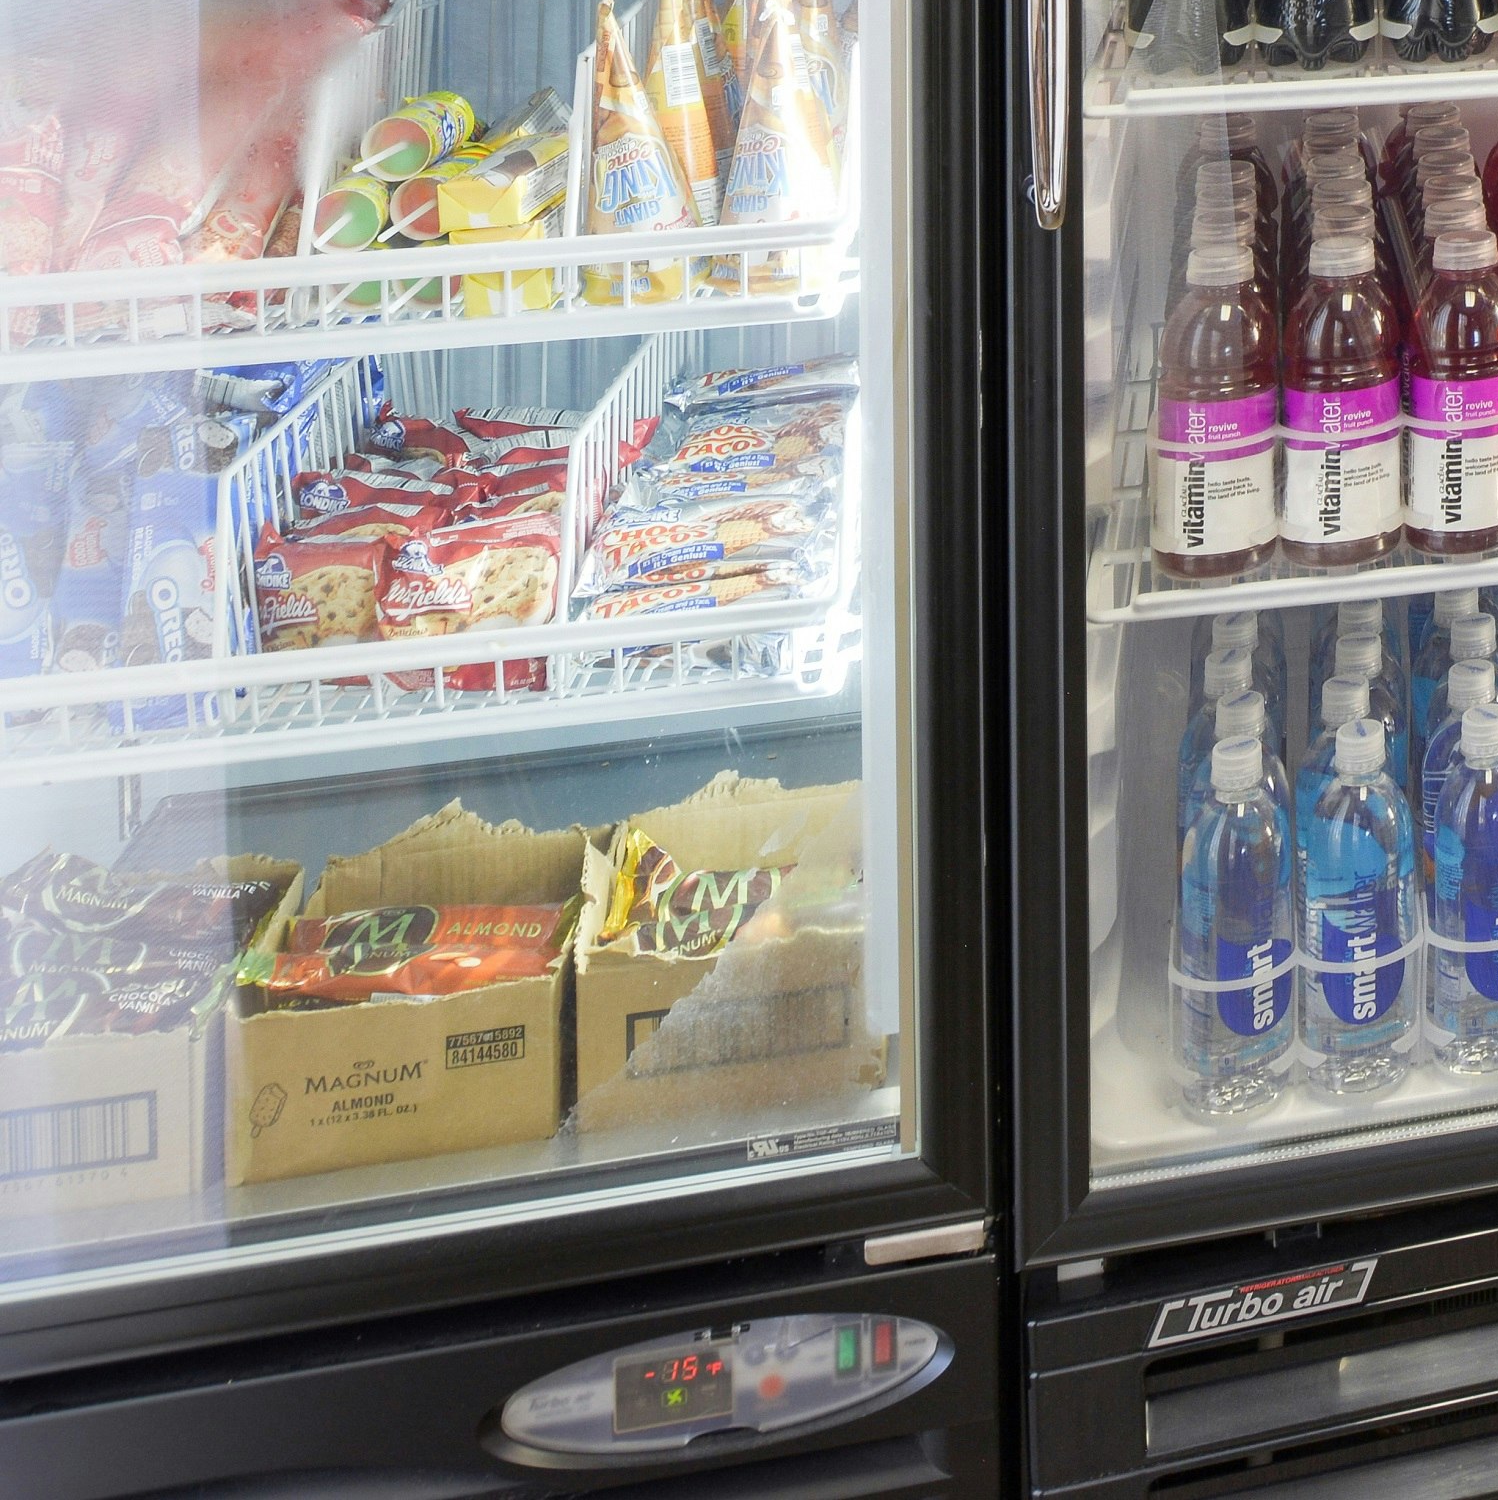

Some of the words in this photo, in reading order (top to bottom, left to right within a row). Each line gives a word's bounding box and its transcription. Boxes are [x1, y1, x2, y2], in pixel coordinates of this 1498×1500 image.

[1465, 399, 1494, 410] revive
[1344, 409, 1372, 421] revive
[1208, 422, 1238, 433] revive
[1222, 431, 1241, 441] punch
[192, 887, 241, 900] VANILLA
[447, 921, 543, 939] ALMOND
[451, 1041, 518, 1066] 84144580
[304, 1060, 423, 1094] MAGNUM
[331, 1093, 395, 1113] ALMOND
[1187, 1284, 1285, 1333] Turbo
[1293, 1276, 1344, 1310] air
